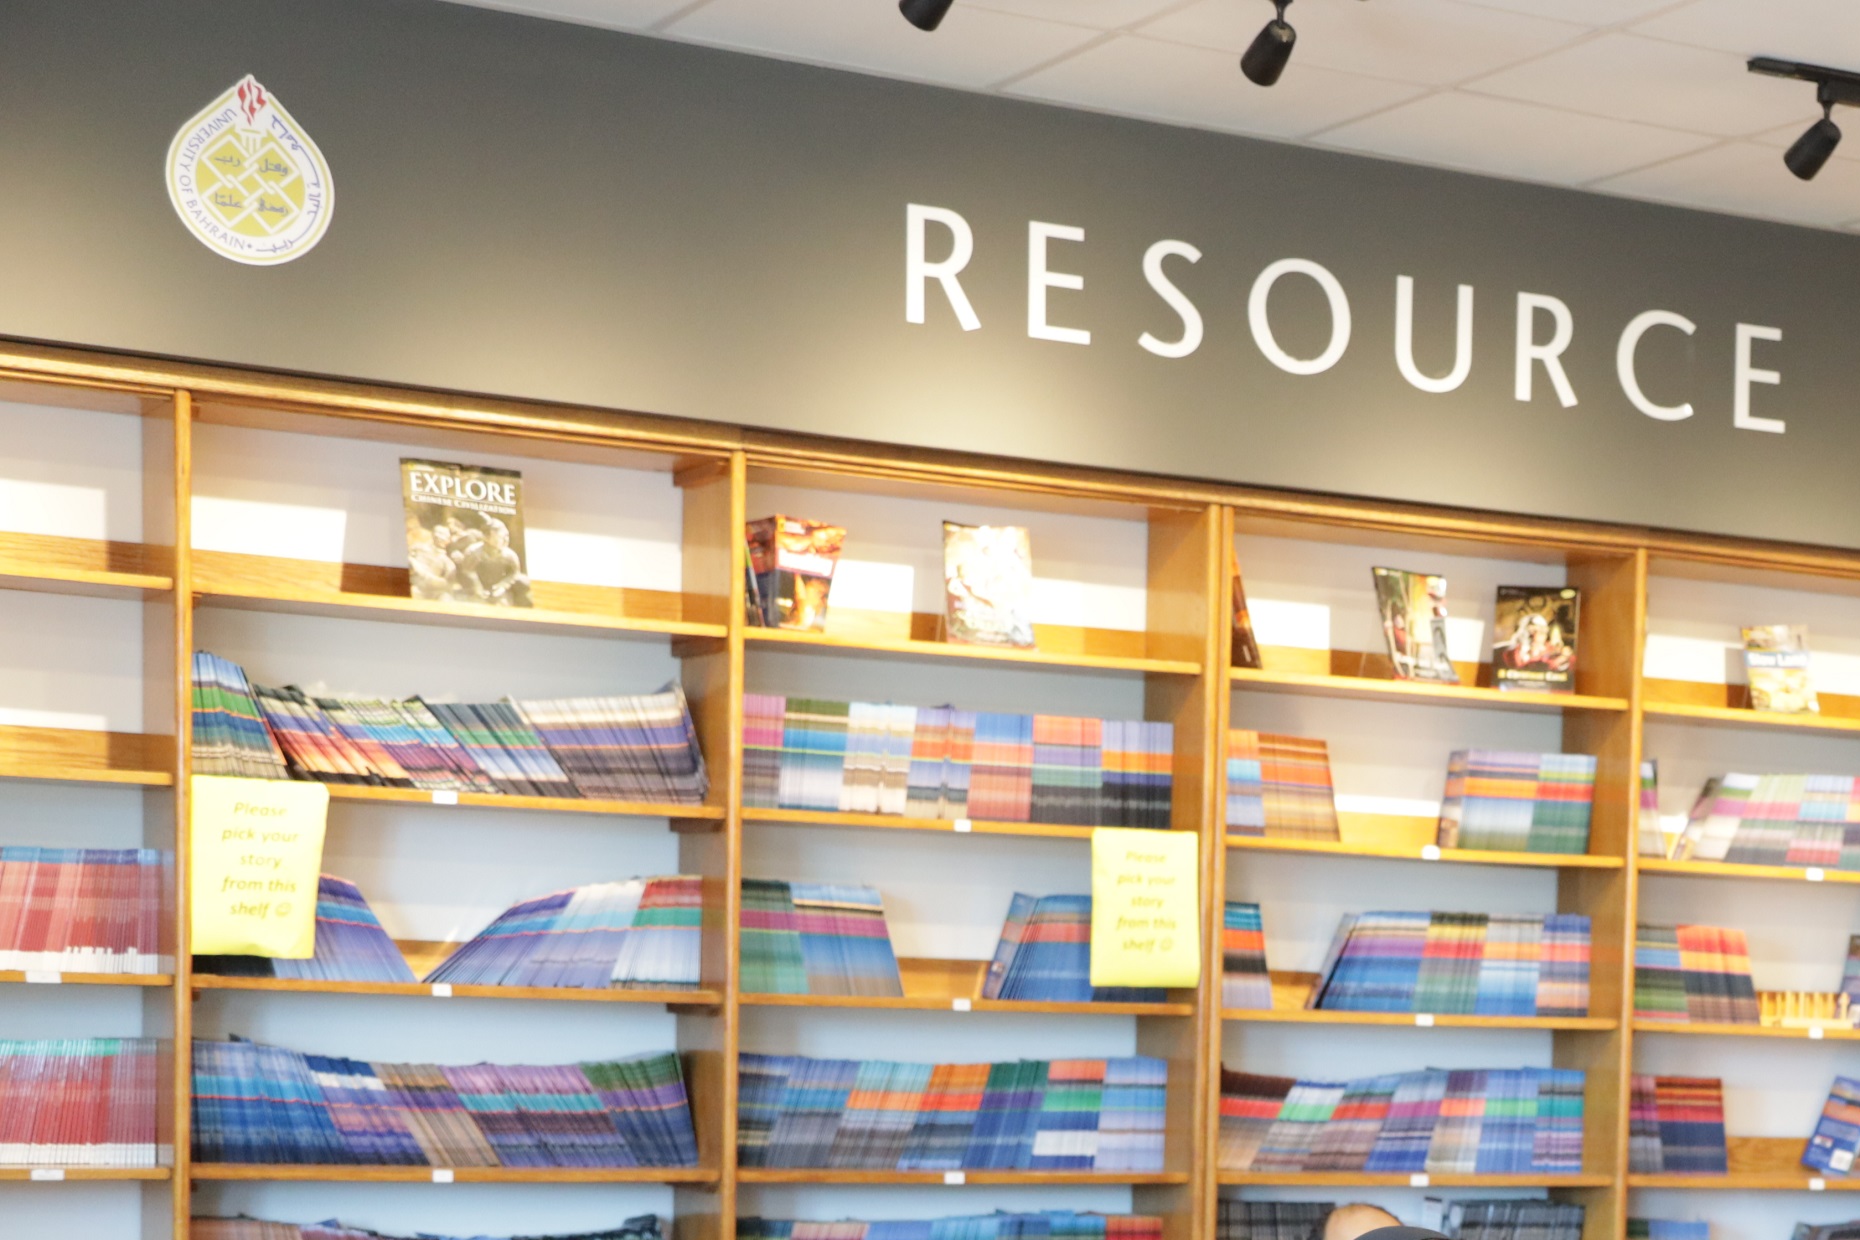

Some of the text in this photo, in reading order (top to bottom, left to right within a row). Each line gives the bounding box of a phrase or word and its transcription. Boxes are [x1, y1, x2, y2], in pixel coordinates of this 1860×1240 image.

[178, 107, 245, 250] UNIVERSITY OF BAHRAIN
[904, 203, 1786, 434] RESOURCE
[410, 471, 516, 506] EXPLORE
[233, 801, 287, 817] Please
[221, 828, 299, 844] pick your
[240, 854, 283, 869] story
[221, 875, 297, 893] from this
[229, 901, 271, 920] shelf
